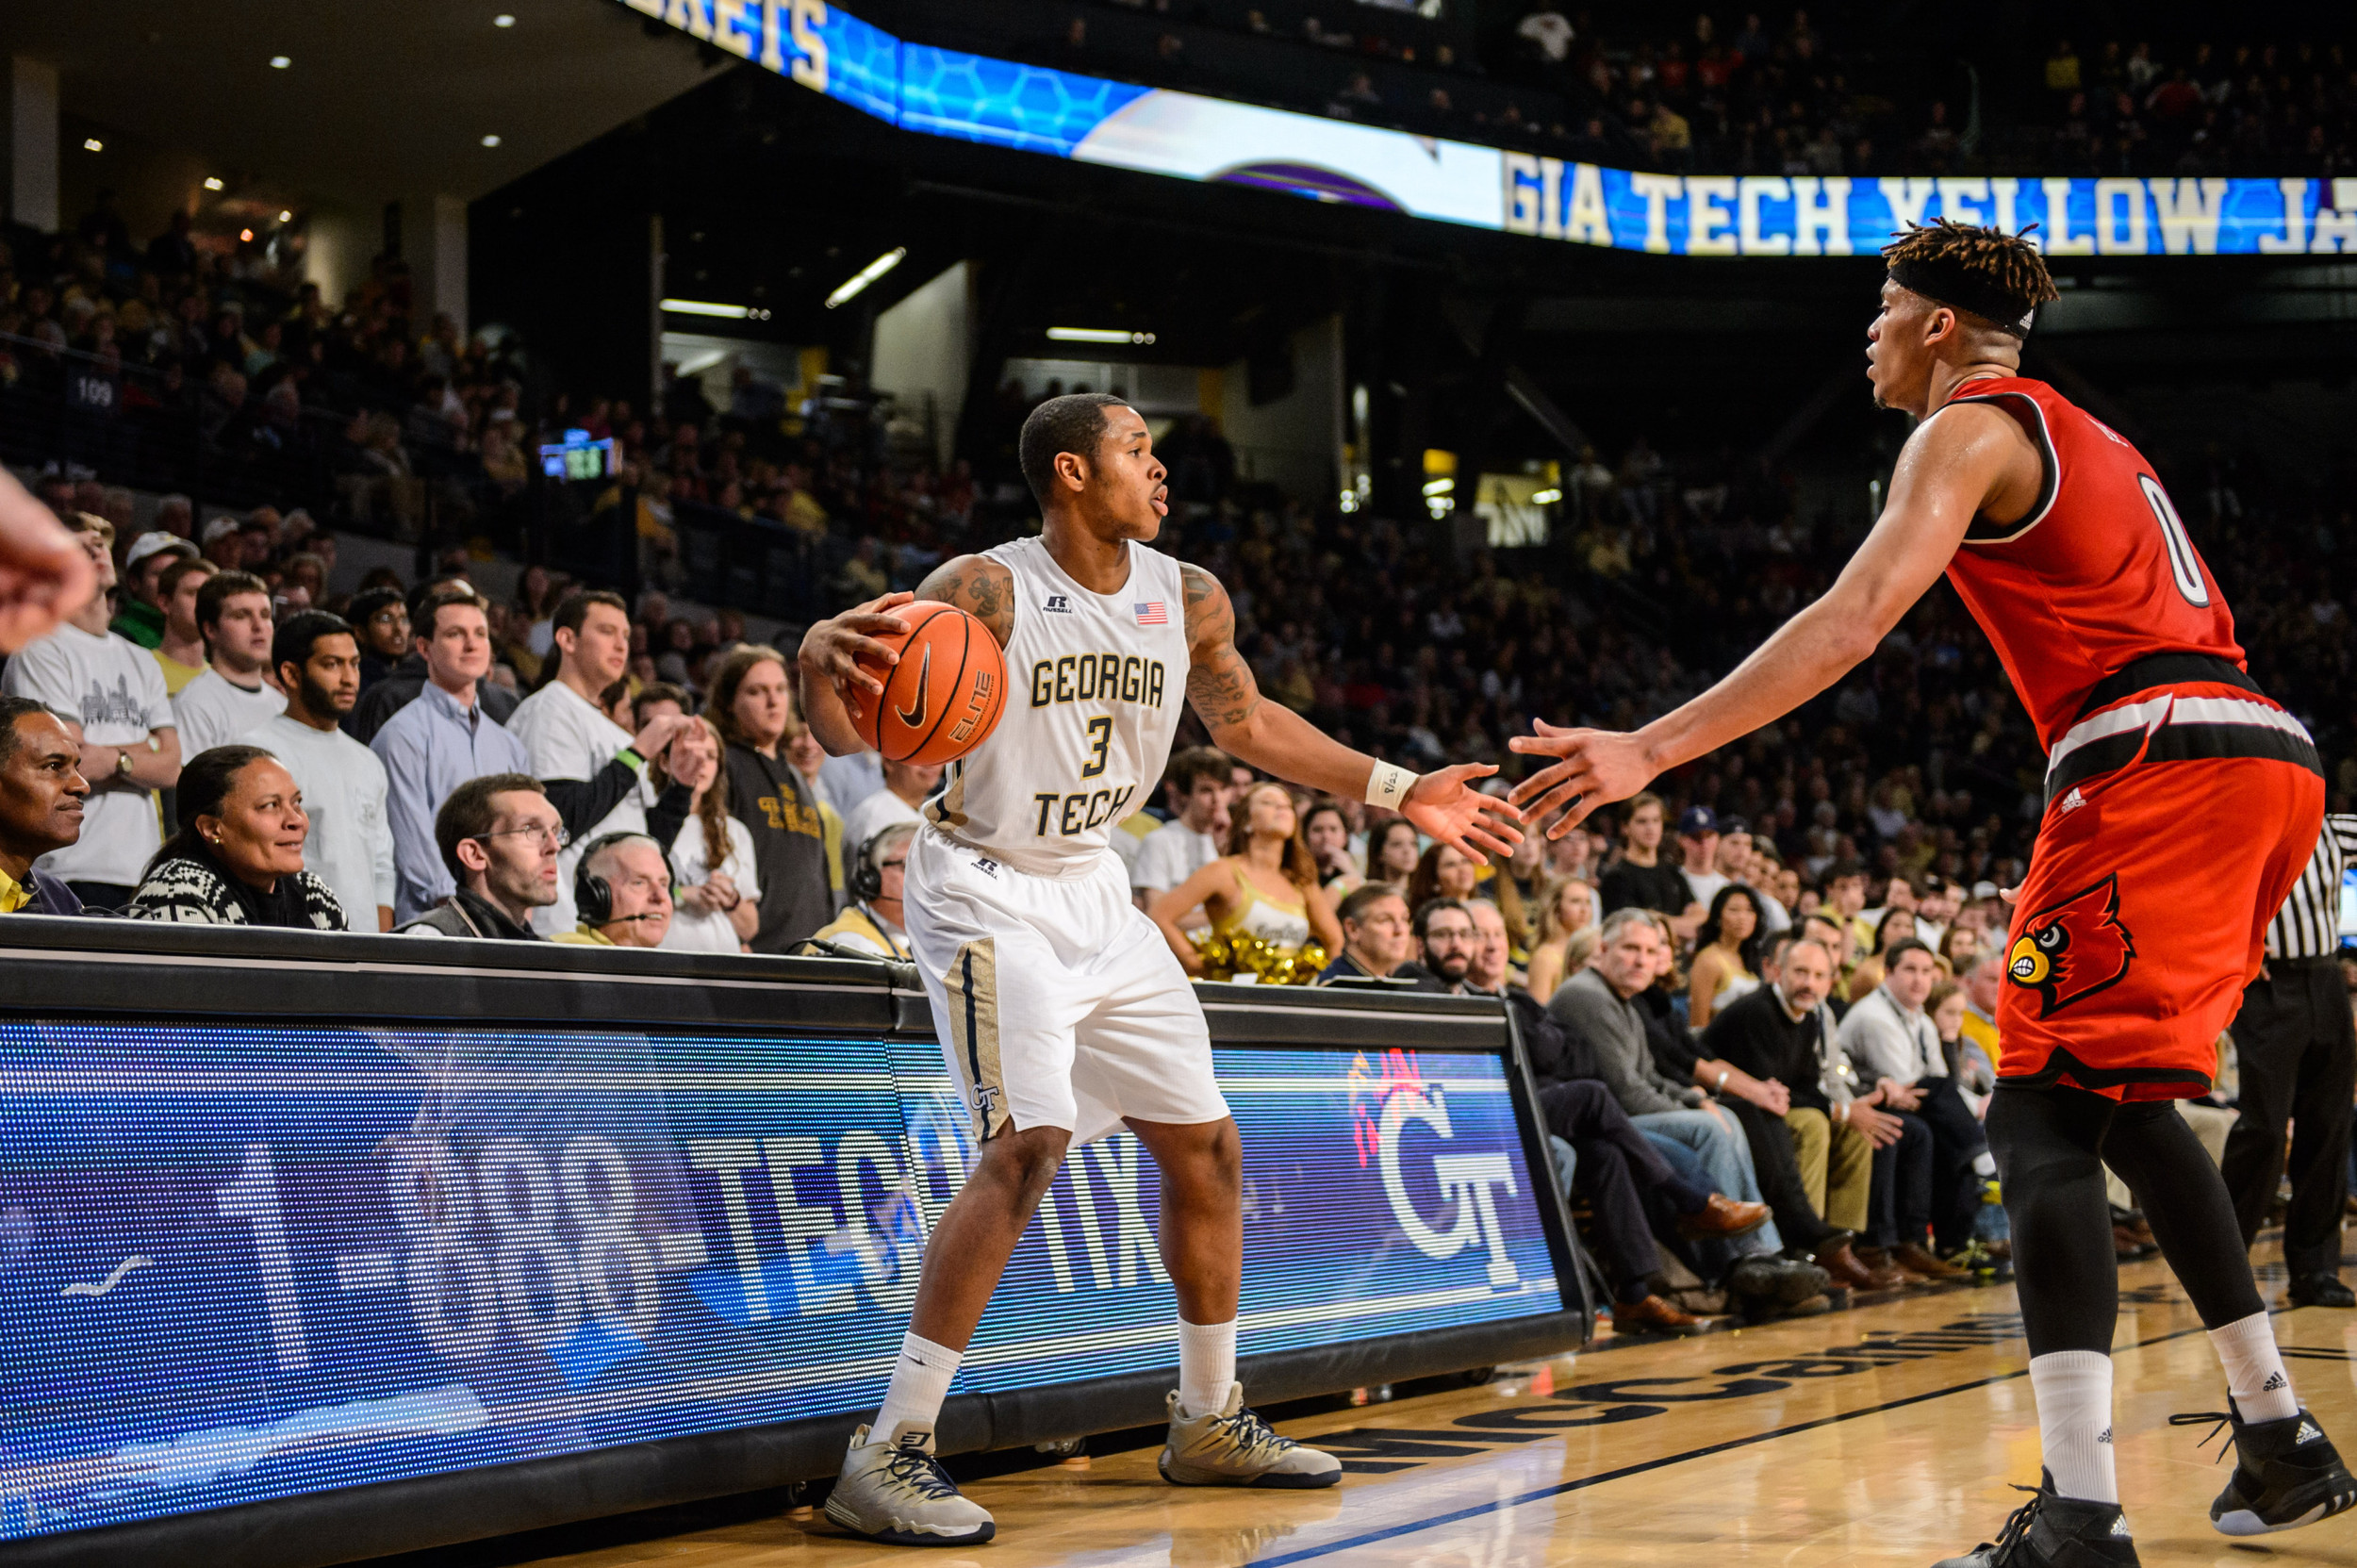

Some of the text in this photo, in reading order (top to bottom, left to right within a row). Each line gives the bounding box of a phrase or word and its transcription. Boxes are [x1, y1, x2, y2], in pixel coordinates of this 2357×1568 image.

[1630, 171, 1854, 256] TECH
[79, 377, 112, 407] 109
[2137, 472, 2210, 608] 0
[948, 668, 991, 742] ELITE
[1030, 652, 1165, 710] GEORGIA
[1080, 715, 1113, 781] 3
[1034, 784, 1135, 836] TECH
[2061, 799, 2087, 814] adidas
[971, 1081, 998, 1112] GT
[1378, 1084, 1519, 1289] GT
[2263, 1381, 2287, 1392] adidas
